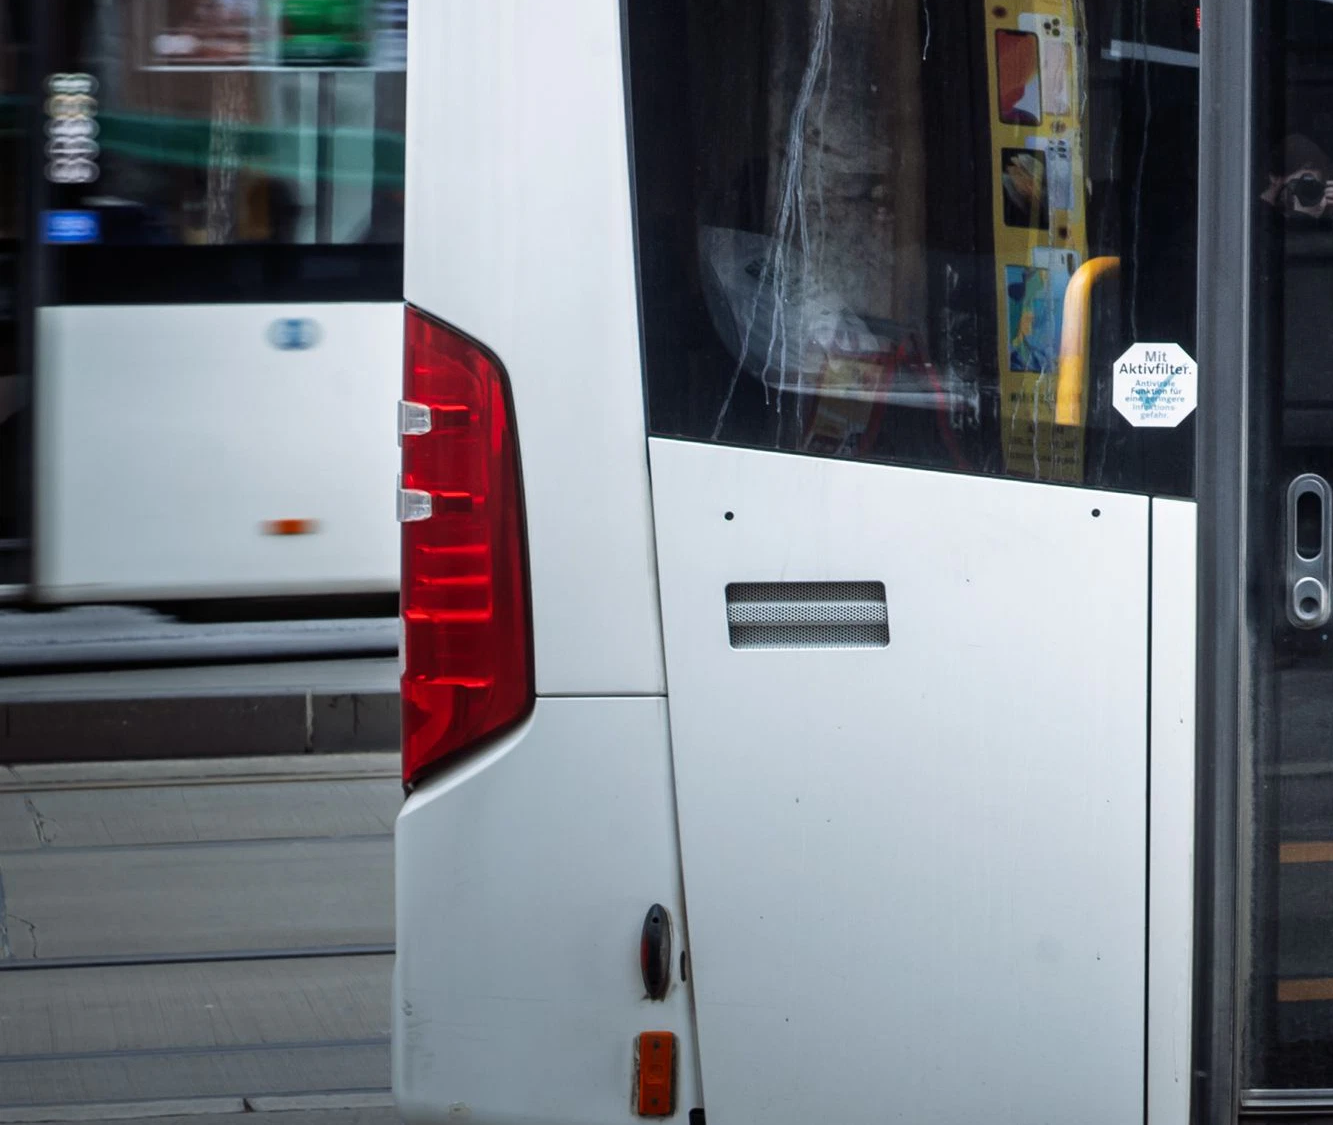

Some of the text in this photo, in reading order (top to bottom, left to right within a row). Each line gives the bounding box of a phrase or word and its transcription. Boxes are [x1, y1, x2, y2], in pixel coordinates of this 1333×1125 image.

[1144, 350, 1167, 362] Mit
[1119, 362, 1192, 375] Aktivfilter.
[1131, 387, 1182, 395] Funktion für
